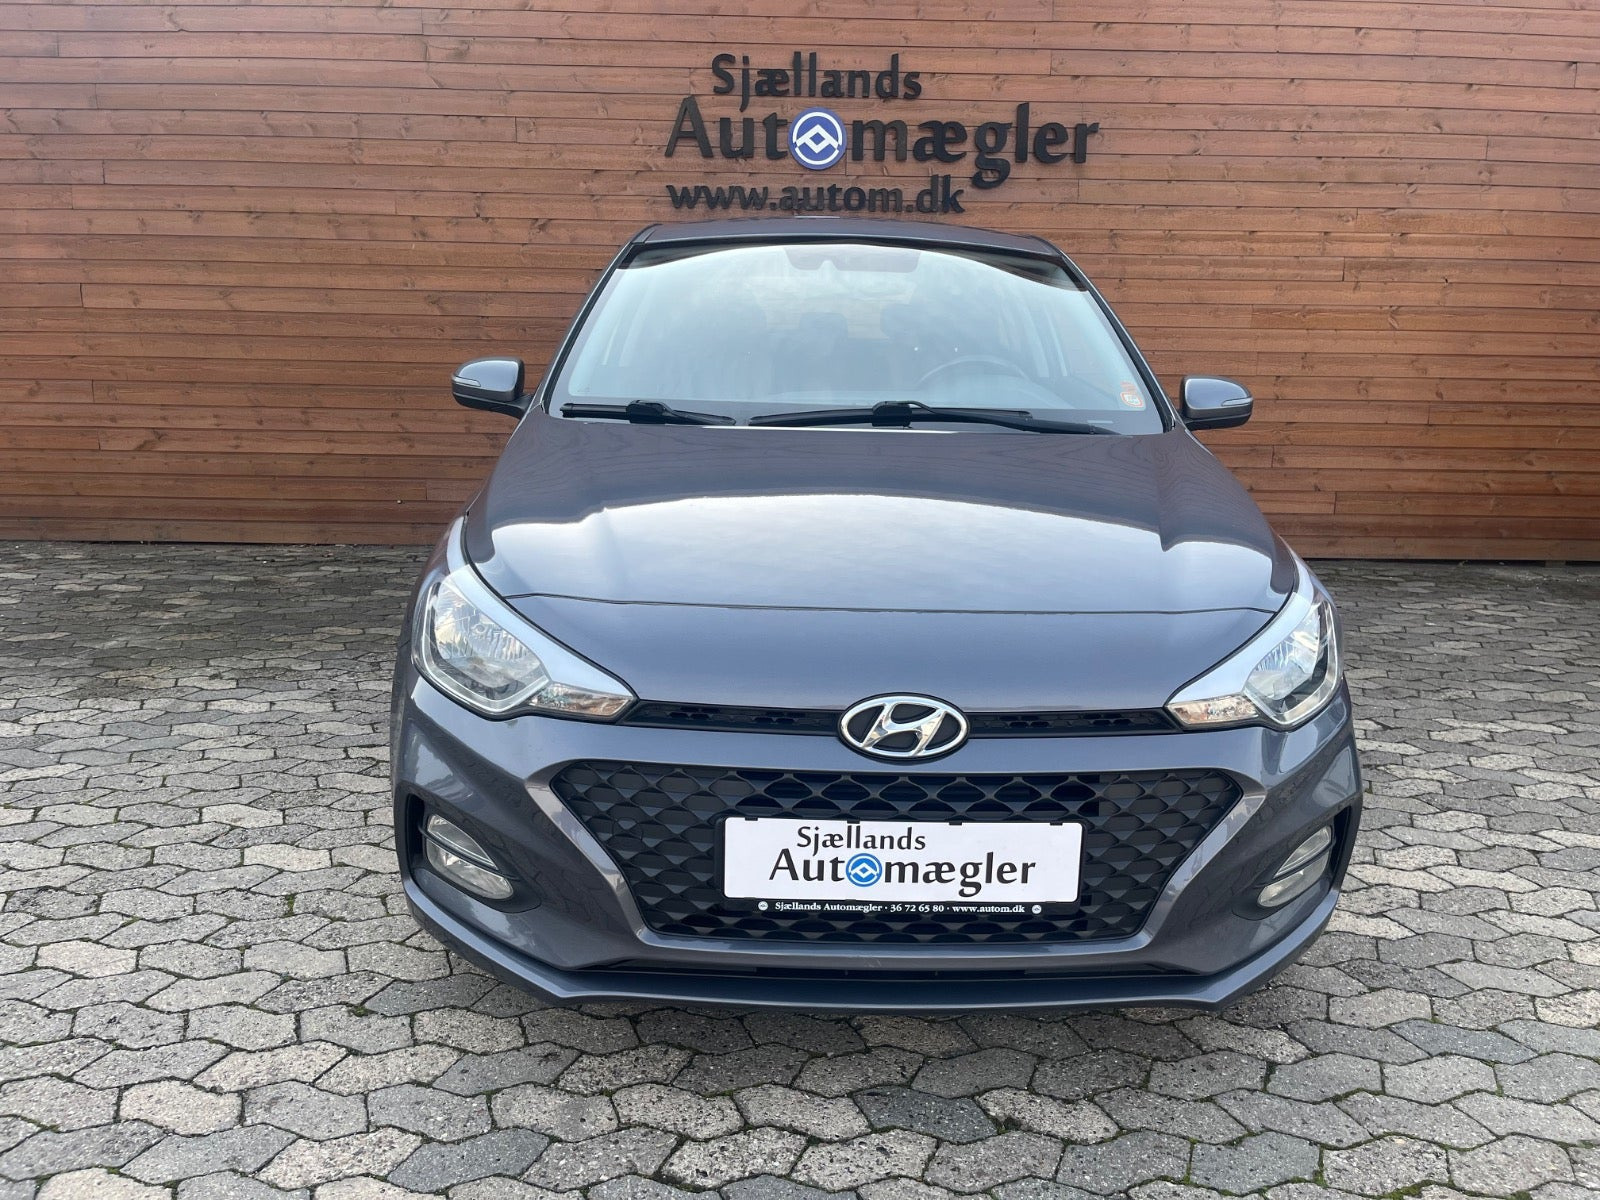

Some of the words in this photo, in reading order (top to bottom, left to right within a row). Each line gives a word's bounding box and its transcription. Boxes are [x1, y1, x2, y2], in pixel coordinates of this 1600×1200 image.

[711, 51, 922, 112] Sjællands
[666, 174, 965, 214] www.autom.dk
[796, 825, 926, 856] Sjællands
[775, 902, 821, 912] Sjællands
[823, 903, 883, 913] Automægler
[890, 904, 902, 912] 36
[904, 904, 916, 912] 72
[918, 904, 930, 913] 65
[932, 904, 945, 912] 80
[952, 904, 1025, 913] www.autom.dk
